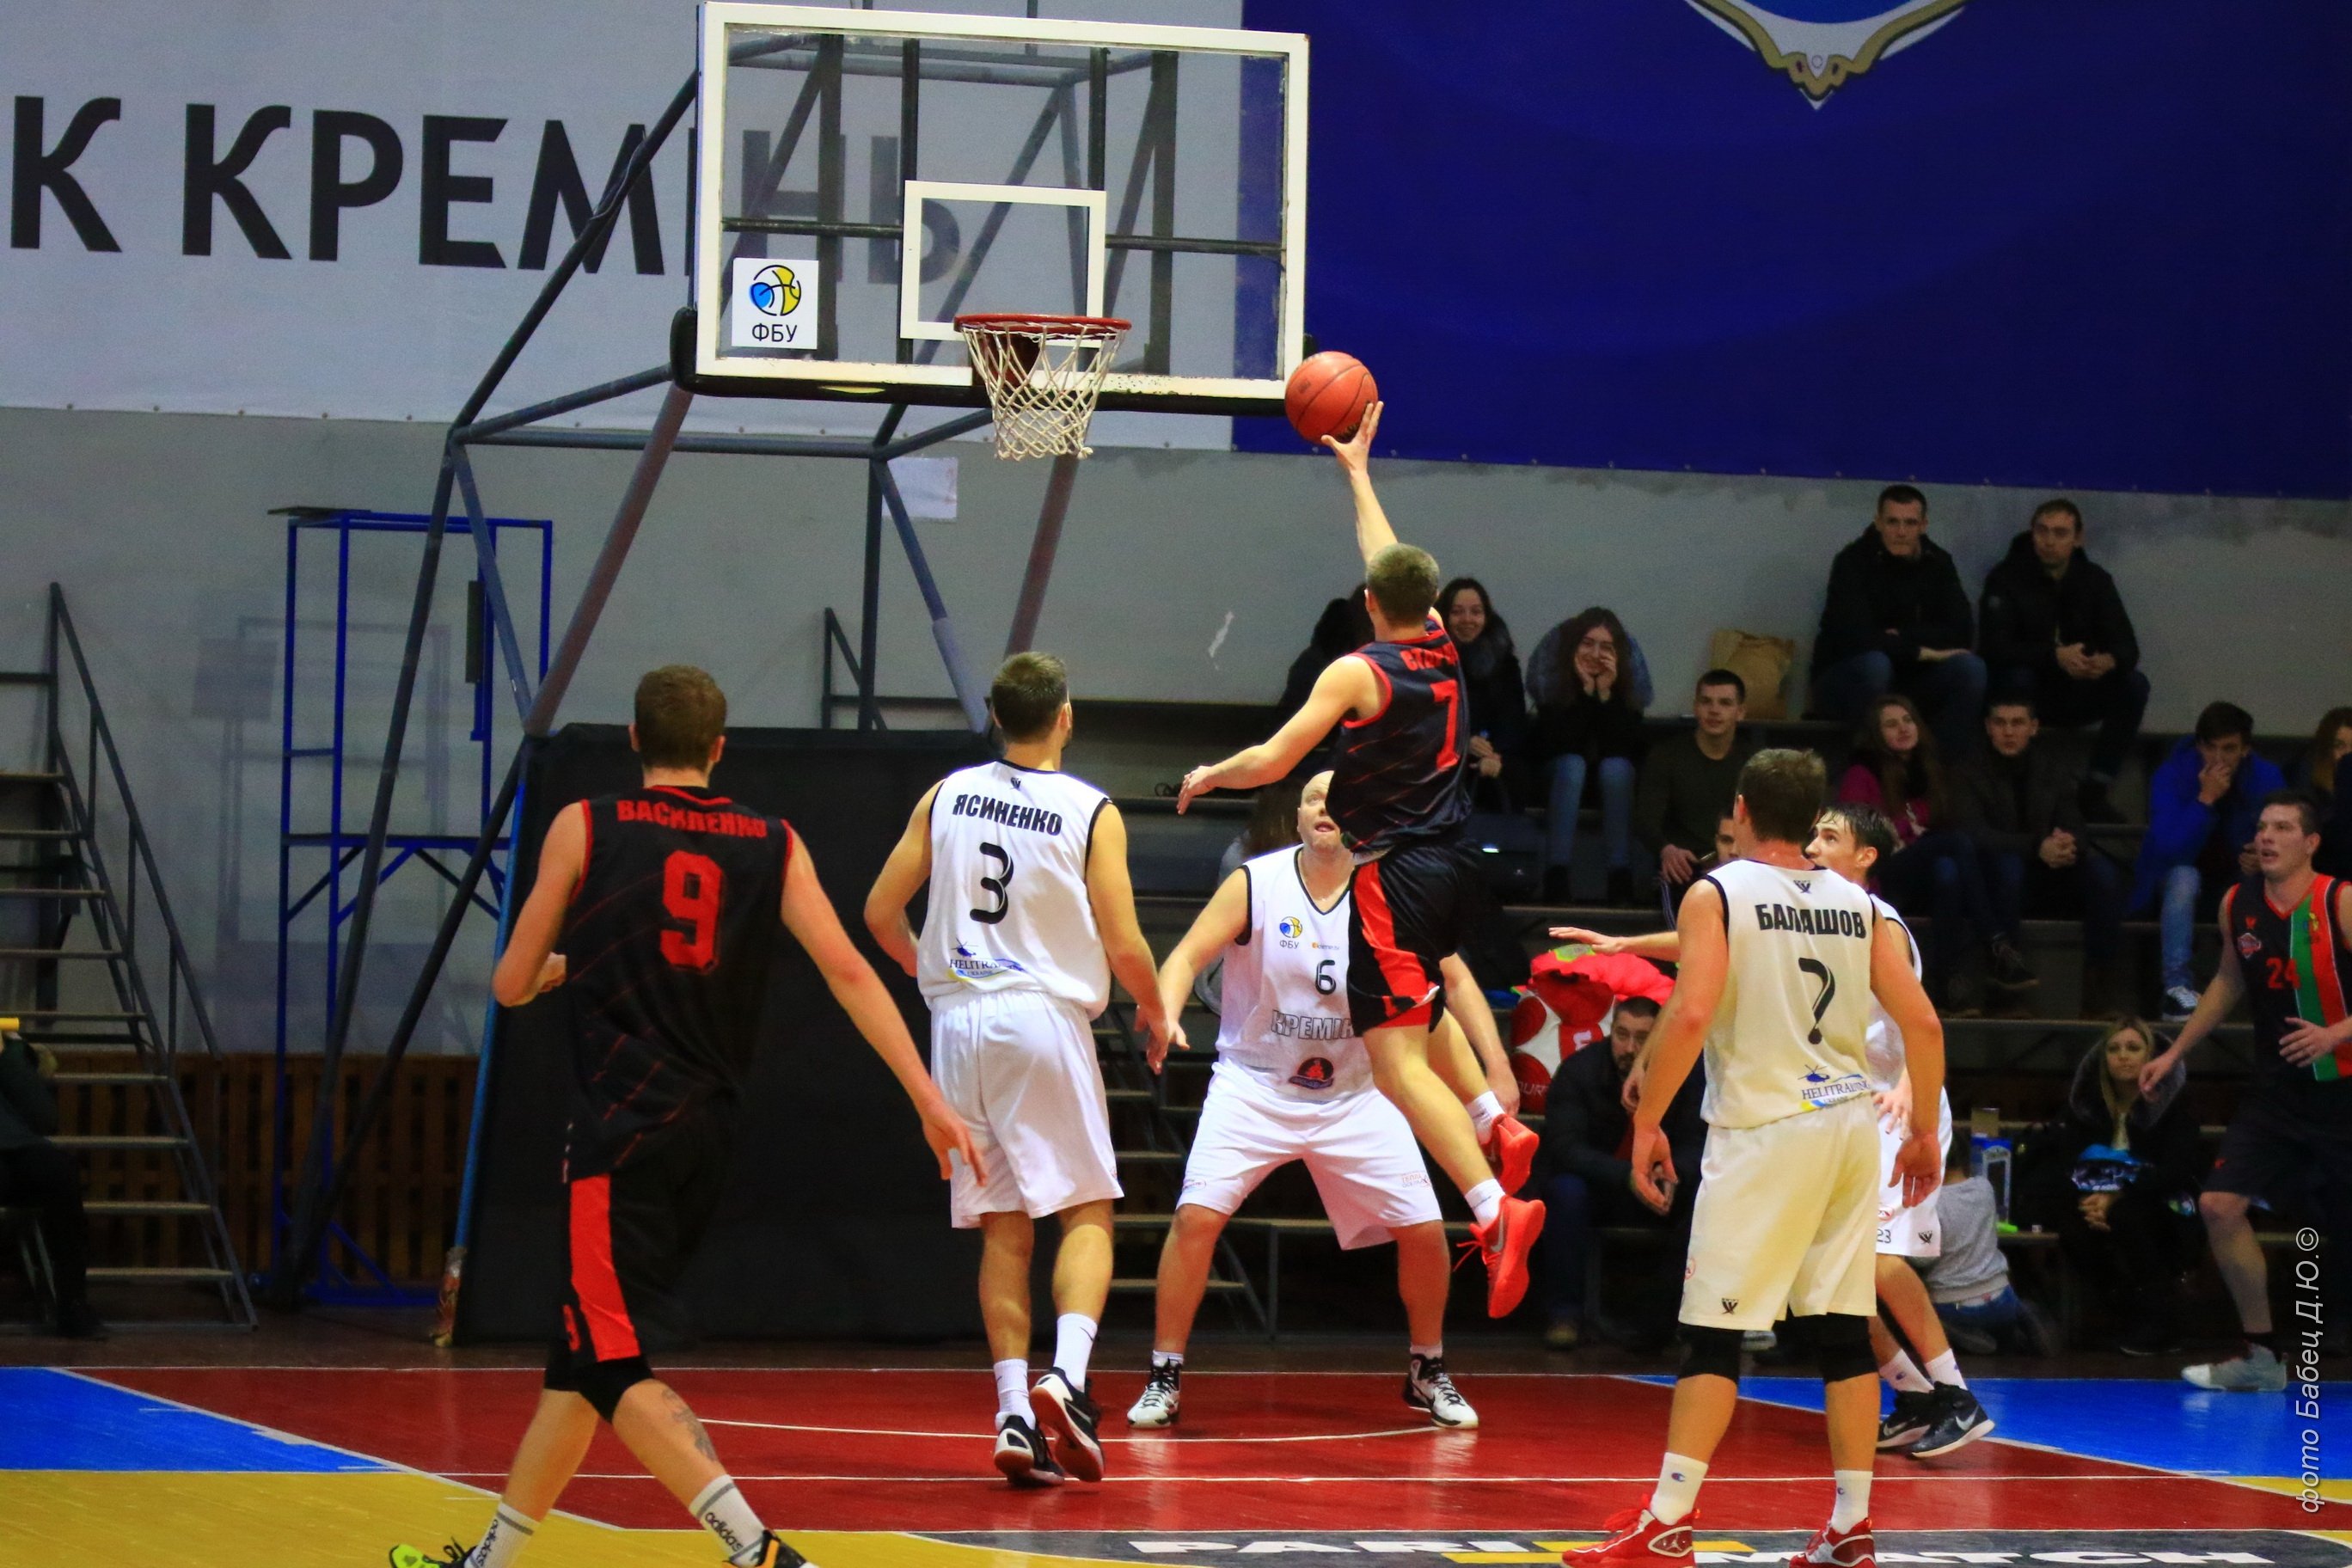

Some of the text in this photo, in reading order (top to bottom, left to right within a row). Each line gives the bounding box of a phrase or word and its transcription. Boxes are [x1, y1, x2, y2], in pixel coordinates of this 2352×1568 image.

[751, 323, 798, 343] ФБУ
[952, 793, 1063, 836] ЯСИНЕНКО
[969, 842, 1014, 925] 3
[659, 849, 723, 972] 9
[1755, 903, 1867, 940] БАЛАШОВ
[1279, 939, 1300, 950] ФБУ
[1314, 959, 1337, 995] 6
[2265, 957, 2301, 989] 24
[1271, 1009, 1356, 1041] КРЕМІН
[705, 1511, 744, 1553] adidas
[1127, 1540, 1530, 1553] PARI
